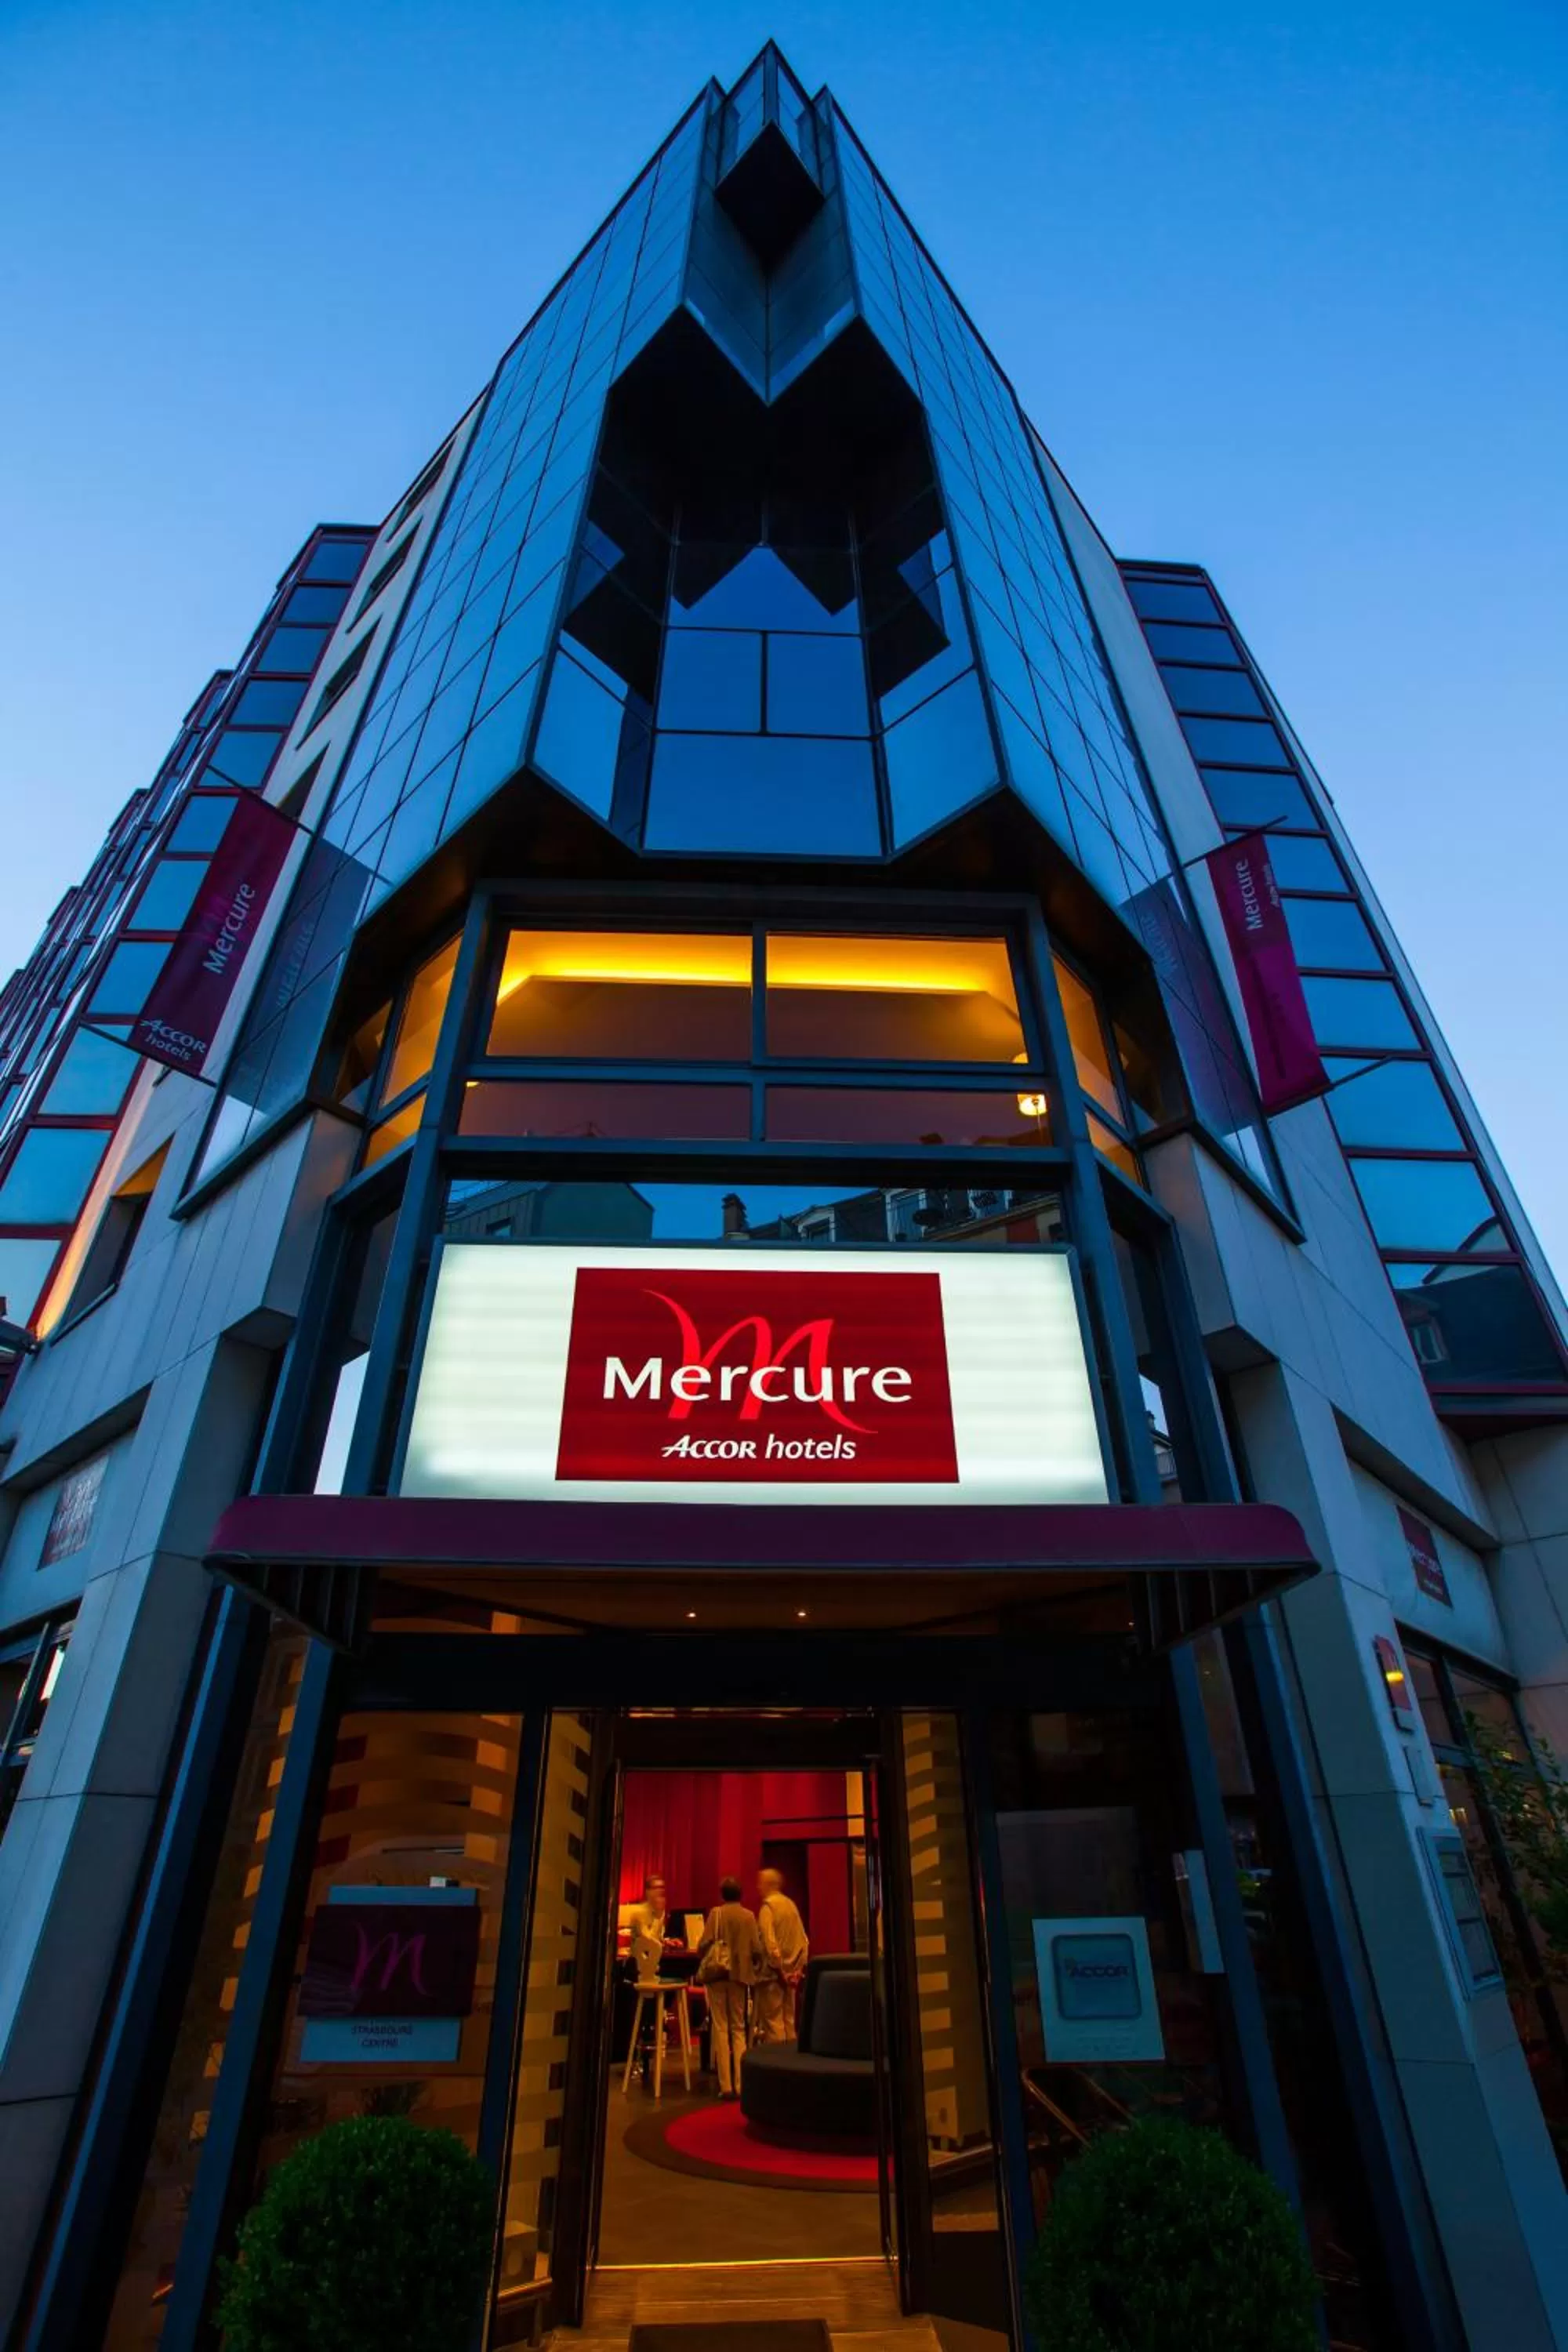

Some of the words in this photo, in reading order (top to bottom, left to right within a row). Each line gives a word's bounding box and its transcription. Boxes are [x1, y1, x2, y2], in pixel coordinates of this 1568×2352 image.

[1236, 858, 1264, 931] Mercure
[202, 883, 256, 975] Mercure
[145, 1034, 193, 1061] hotels
[603, 1356, 913, 1403] Mercure
[764, 1434, 856, 1460] hotels
